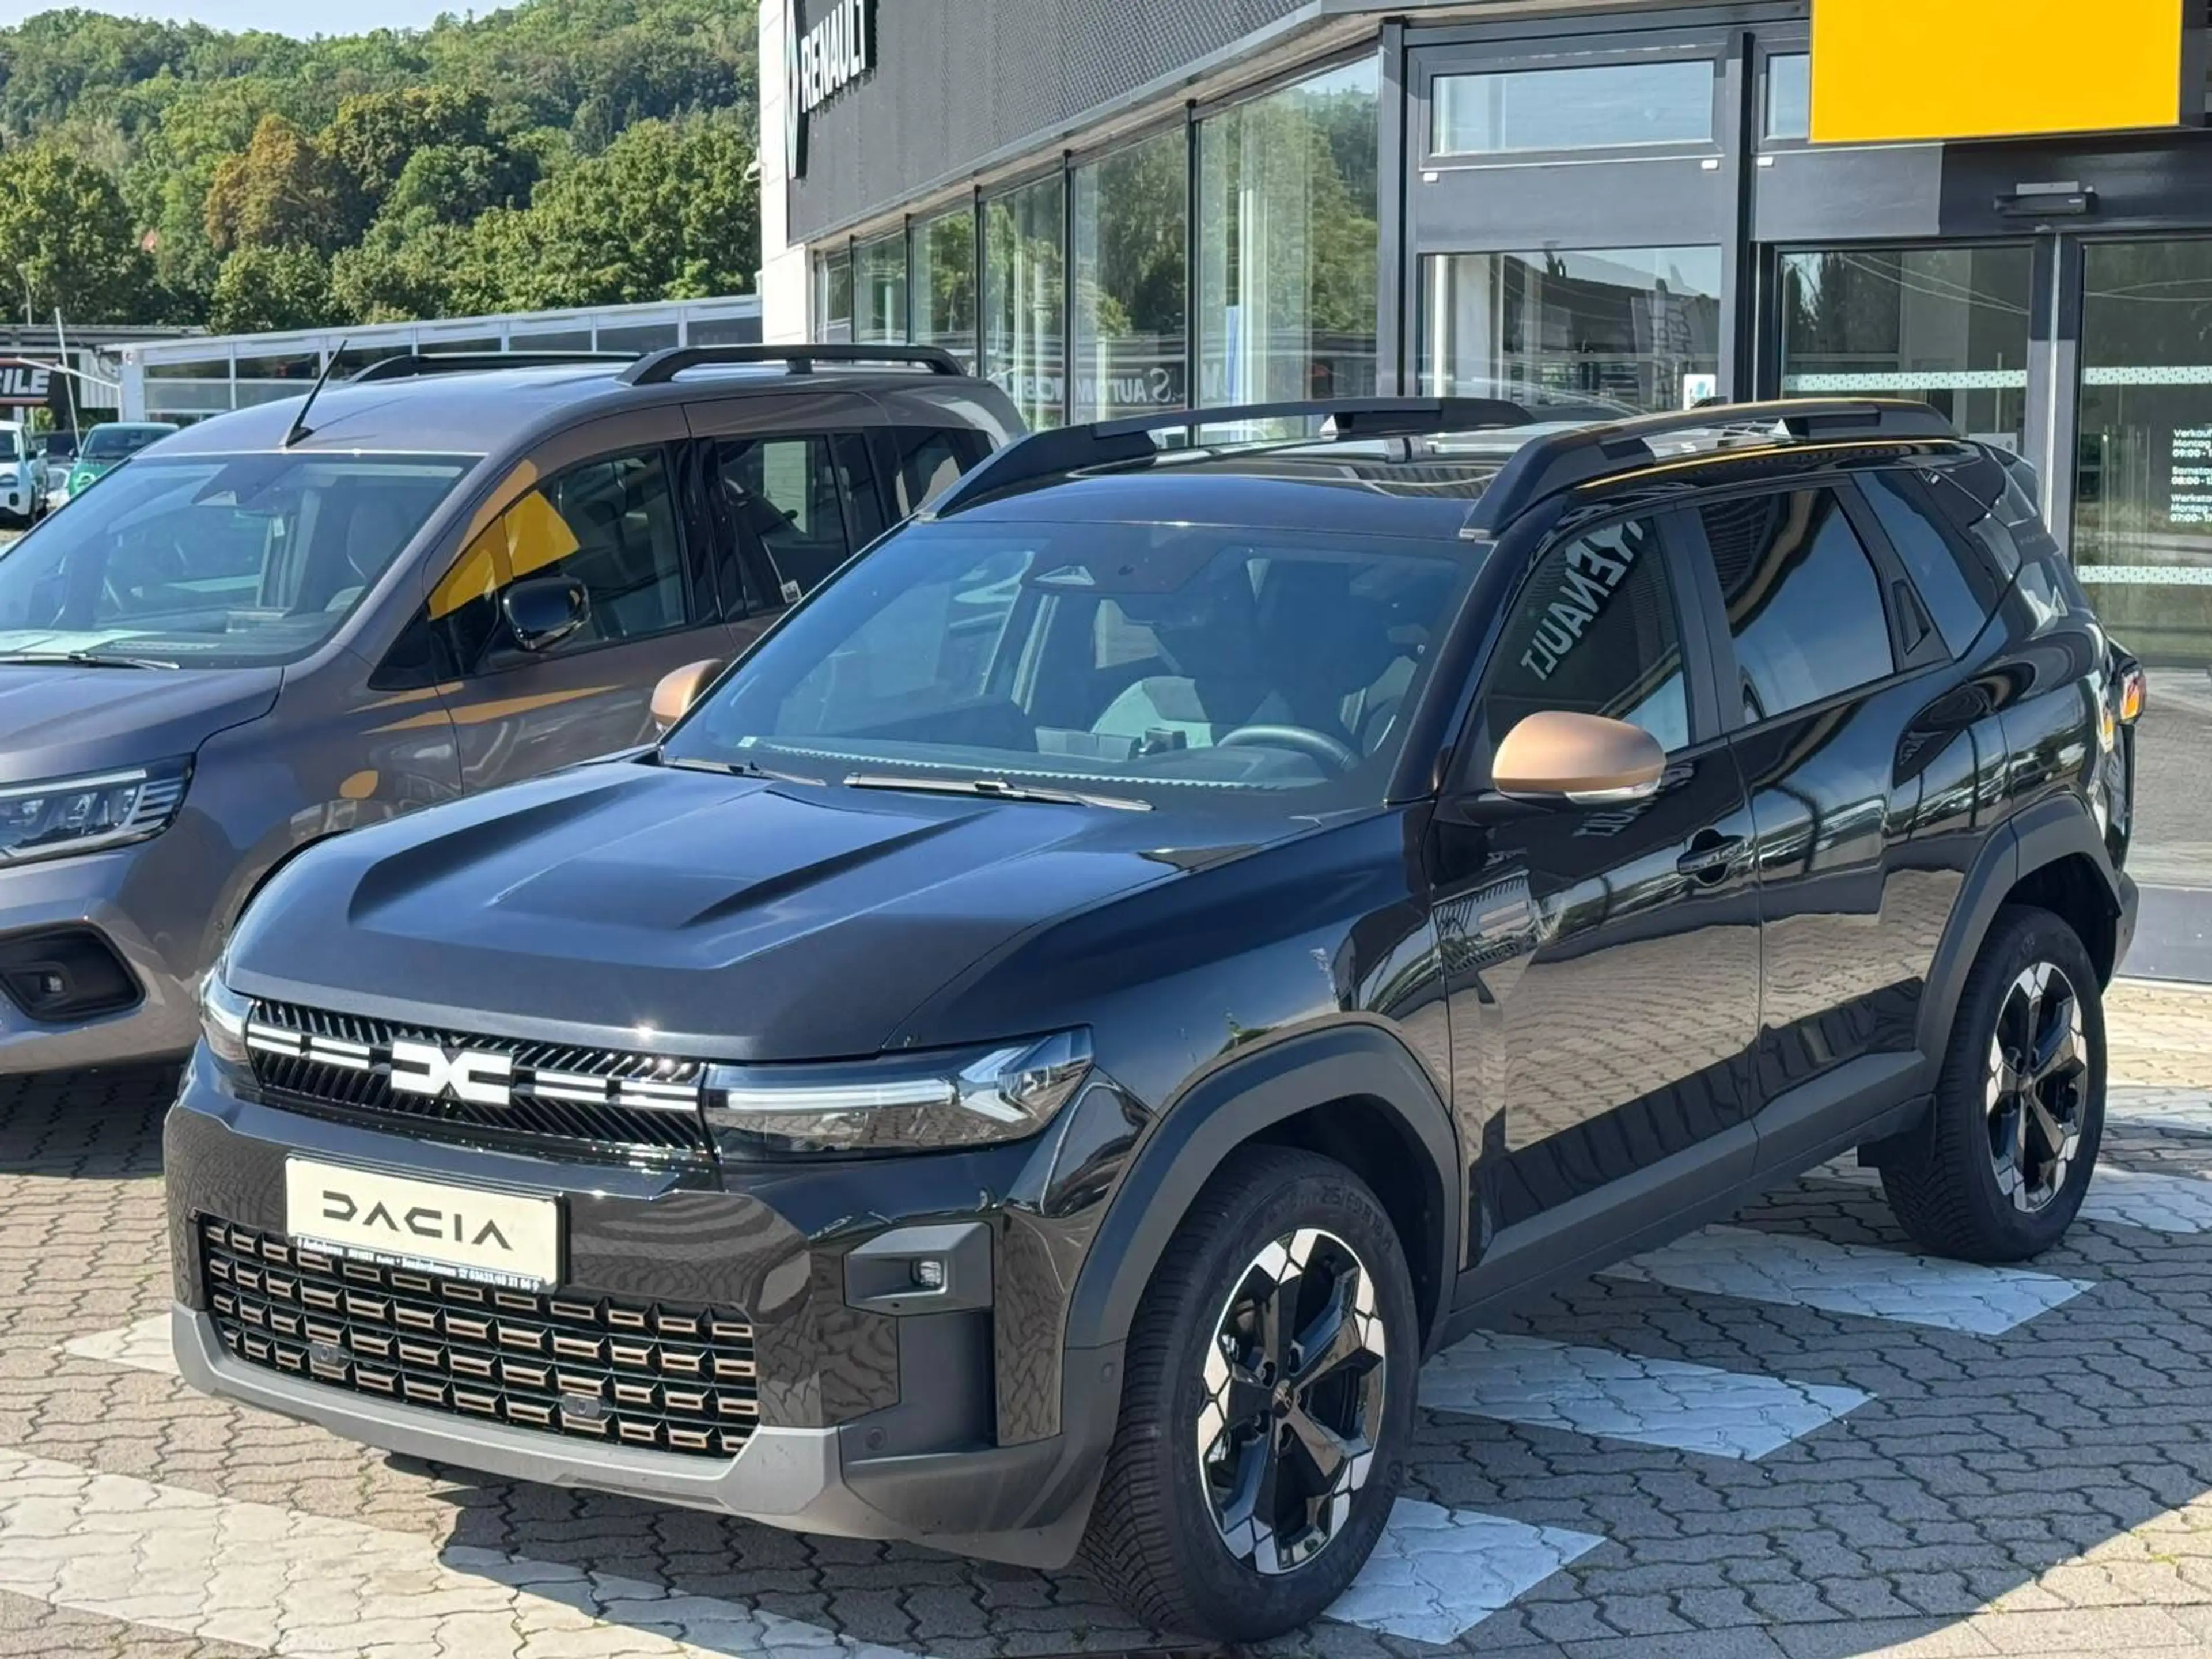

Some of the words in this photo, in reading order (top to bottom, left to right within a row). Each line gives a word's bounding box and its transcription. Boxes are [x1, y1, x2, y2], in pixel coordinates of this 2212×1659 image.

[801, 0, 866, 113] RENAULT
[0, 368, 50, 395] ILE
[322, 1190, 515, 1251] DACIA
